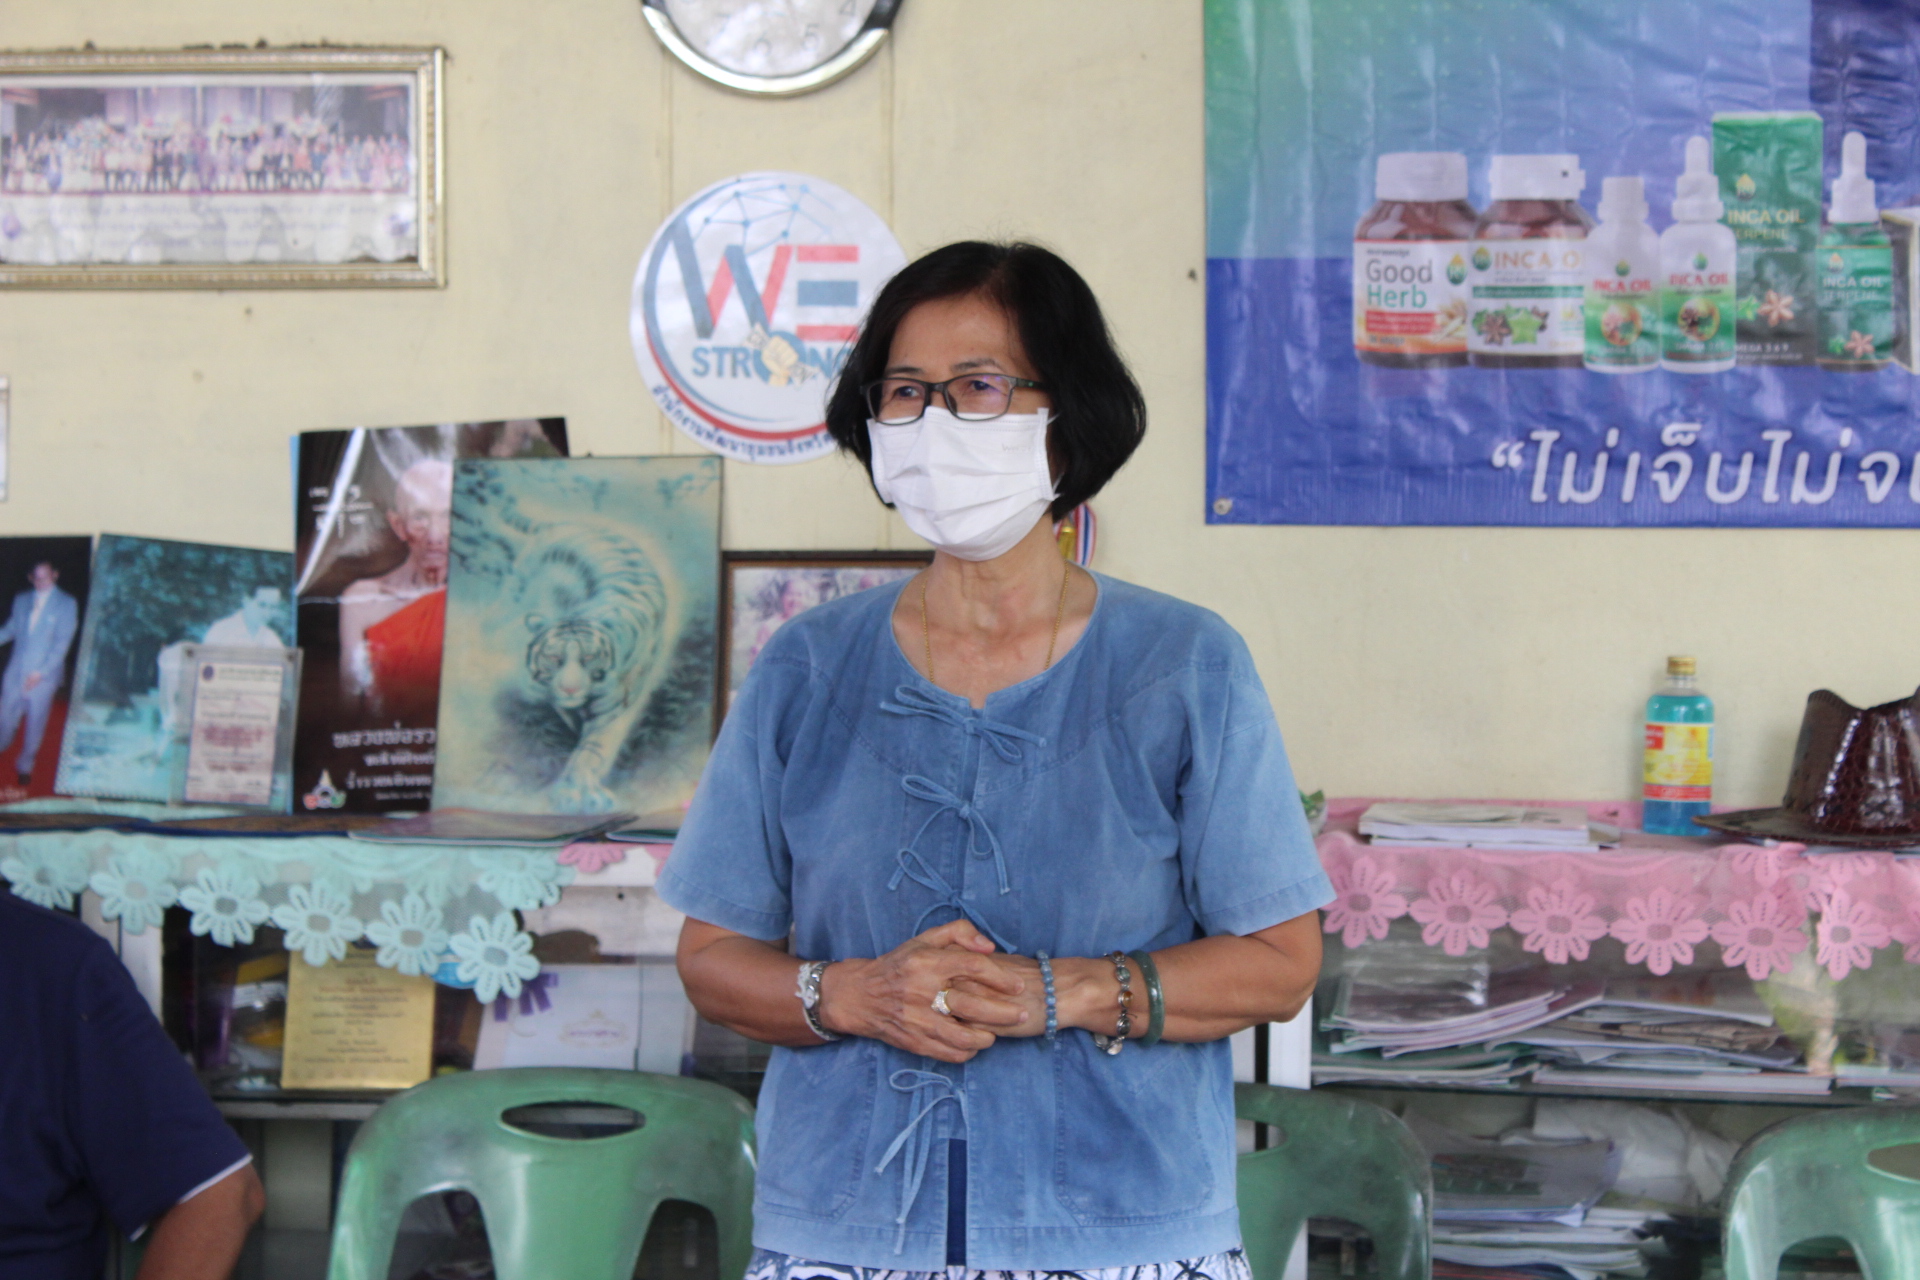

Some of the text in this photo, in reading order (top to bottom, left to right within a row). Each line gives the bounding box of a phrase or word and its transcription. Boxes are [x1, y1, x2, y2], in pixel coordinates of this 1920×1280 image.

[1728, 209, 1772, 224] INCA
[1736, 228, 1788, 239] ERPENE
[1494, 250, 1551, 269] INCA
[665, 212, 860, 340] WE
[1366, 258, 1433, 284] Good
[1669, 273, 1704, 285] INCA
[1593, 279, 1627, 292] INCA
[1823, 276, 1857, 288] INCA
[1367, 284, 1428, 308] Herb
[1491, 422, 1920, 504] “ไม่เจ็บไม่จ
